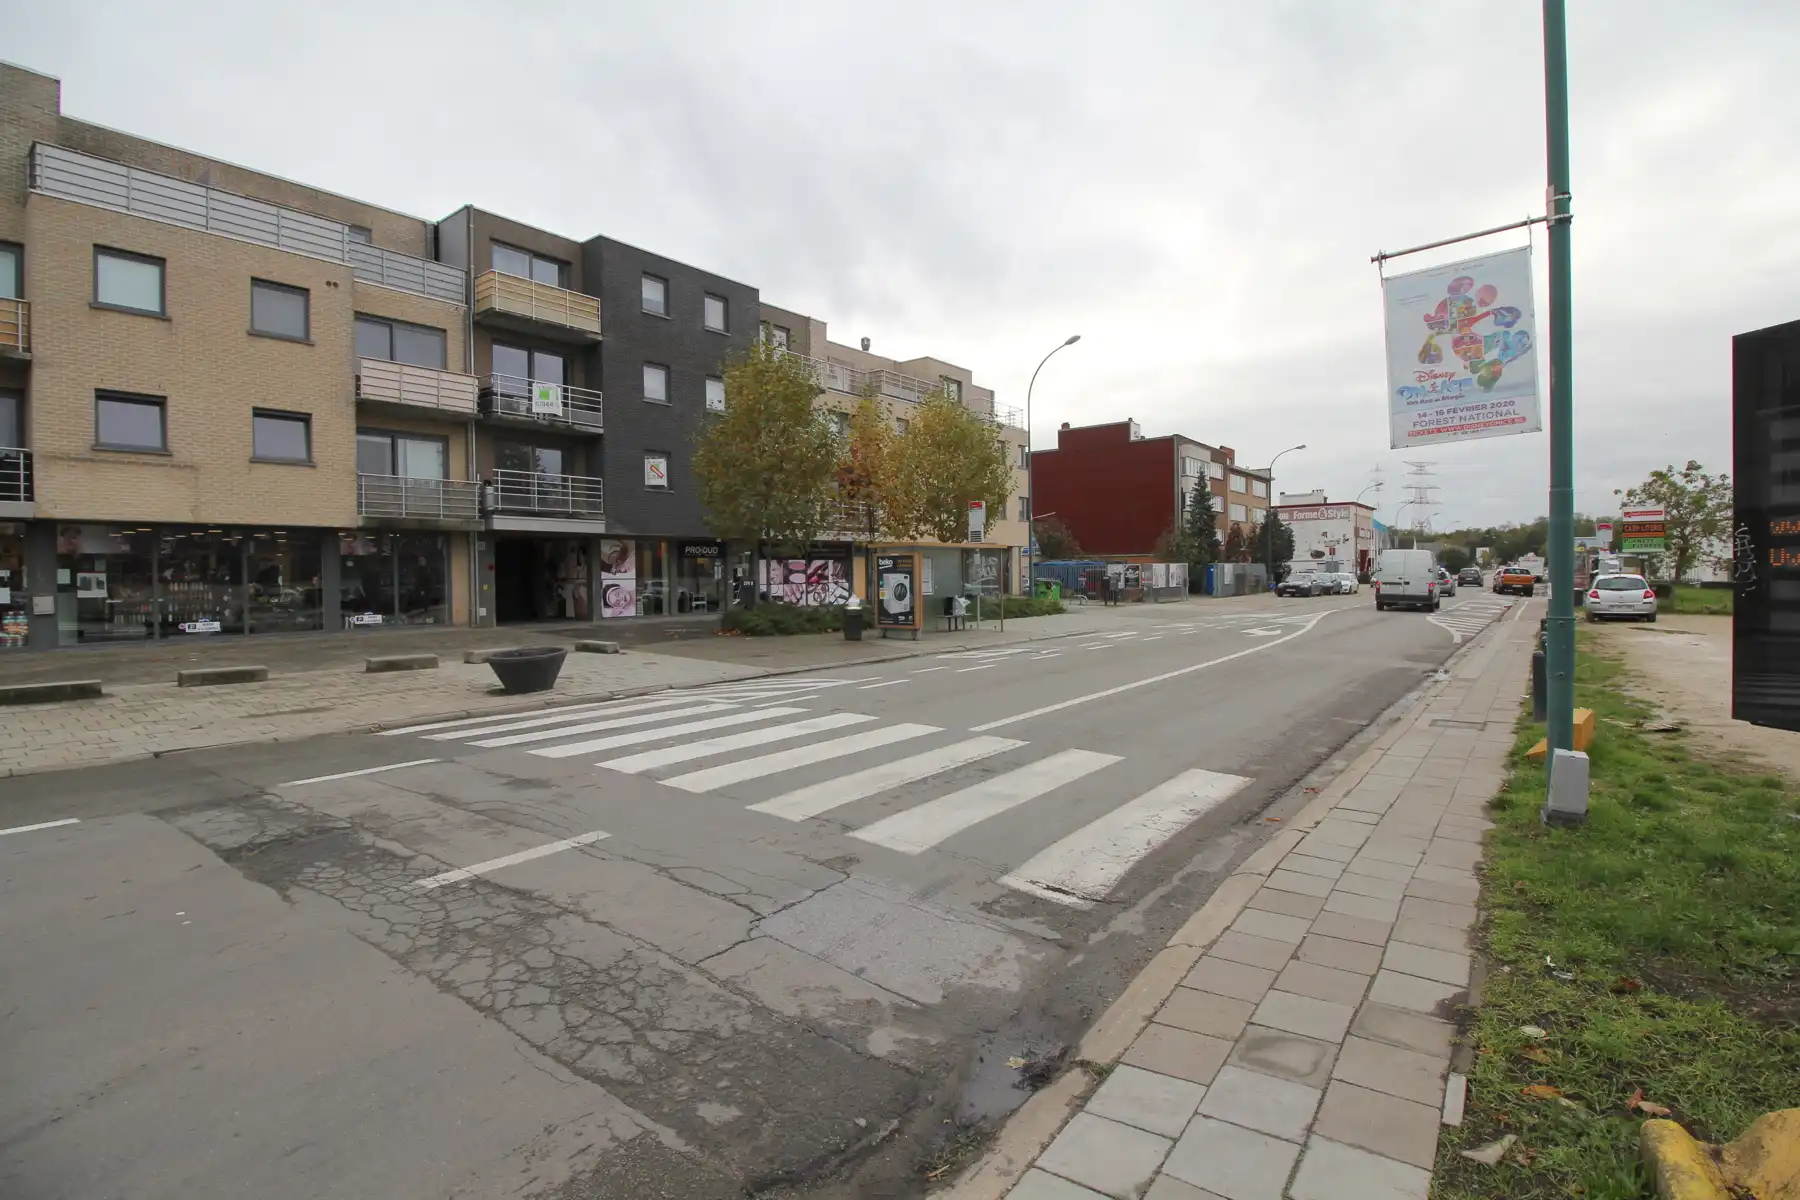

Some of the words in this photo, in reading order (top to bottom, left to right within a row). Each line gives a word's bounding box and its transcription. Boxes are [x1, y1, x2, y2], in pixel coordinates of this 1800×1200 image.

[1413, 369, 1456, 383] Disney
[1490, 400, 1516, 409] 2020
[1413, 416, 1456, 428] FOREST
[1459, 408, 1520, 422] NATIONAL
[1293, 510, 1317, 520] Forme
[879, 558, 894, 566] beko
